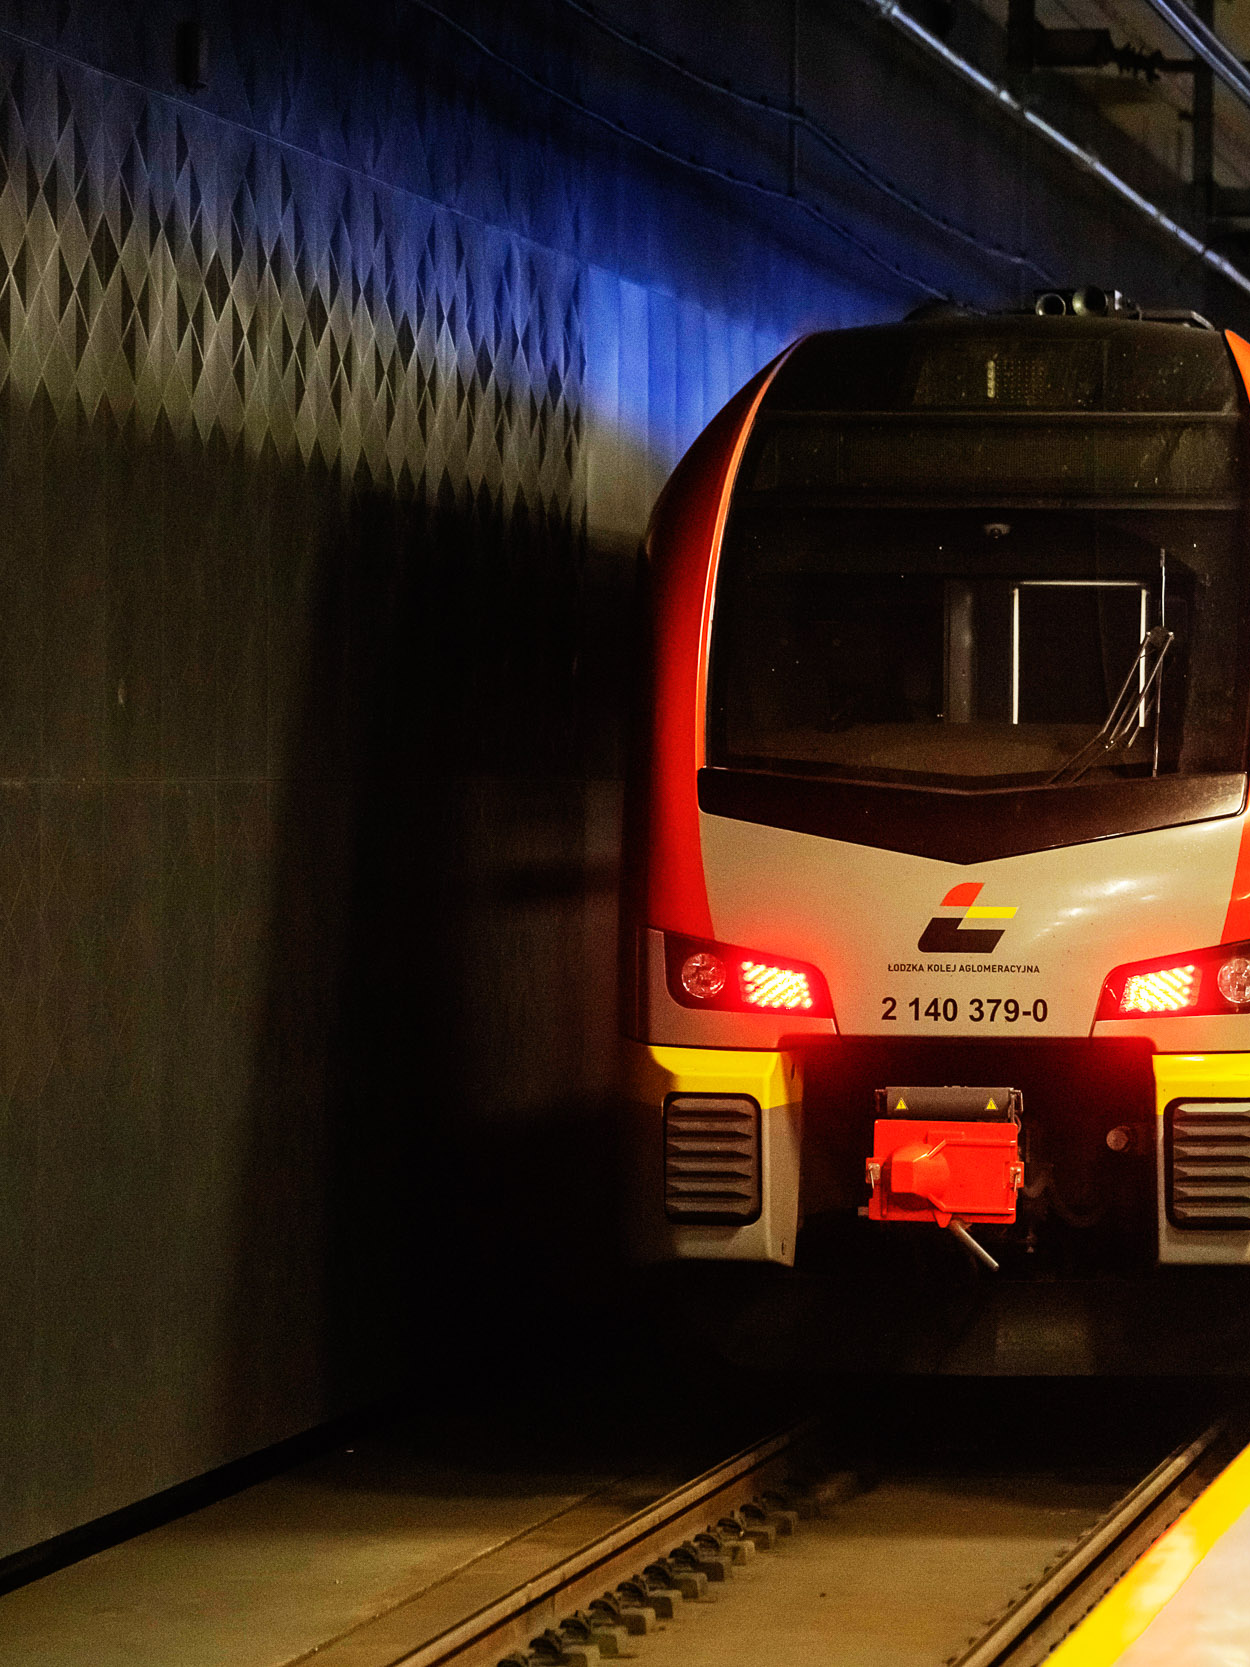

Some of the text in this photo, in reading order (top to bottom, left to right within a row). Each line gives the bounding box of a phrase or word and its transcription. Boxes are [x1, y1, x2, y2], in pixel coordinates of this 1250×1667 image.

[926, 963, 957, 973] KOLEJ
[958, 964, 1040, 974] AGLOMERACYJNA
[881, 997, 1049, 1023] 2 140 379-0
